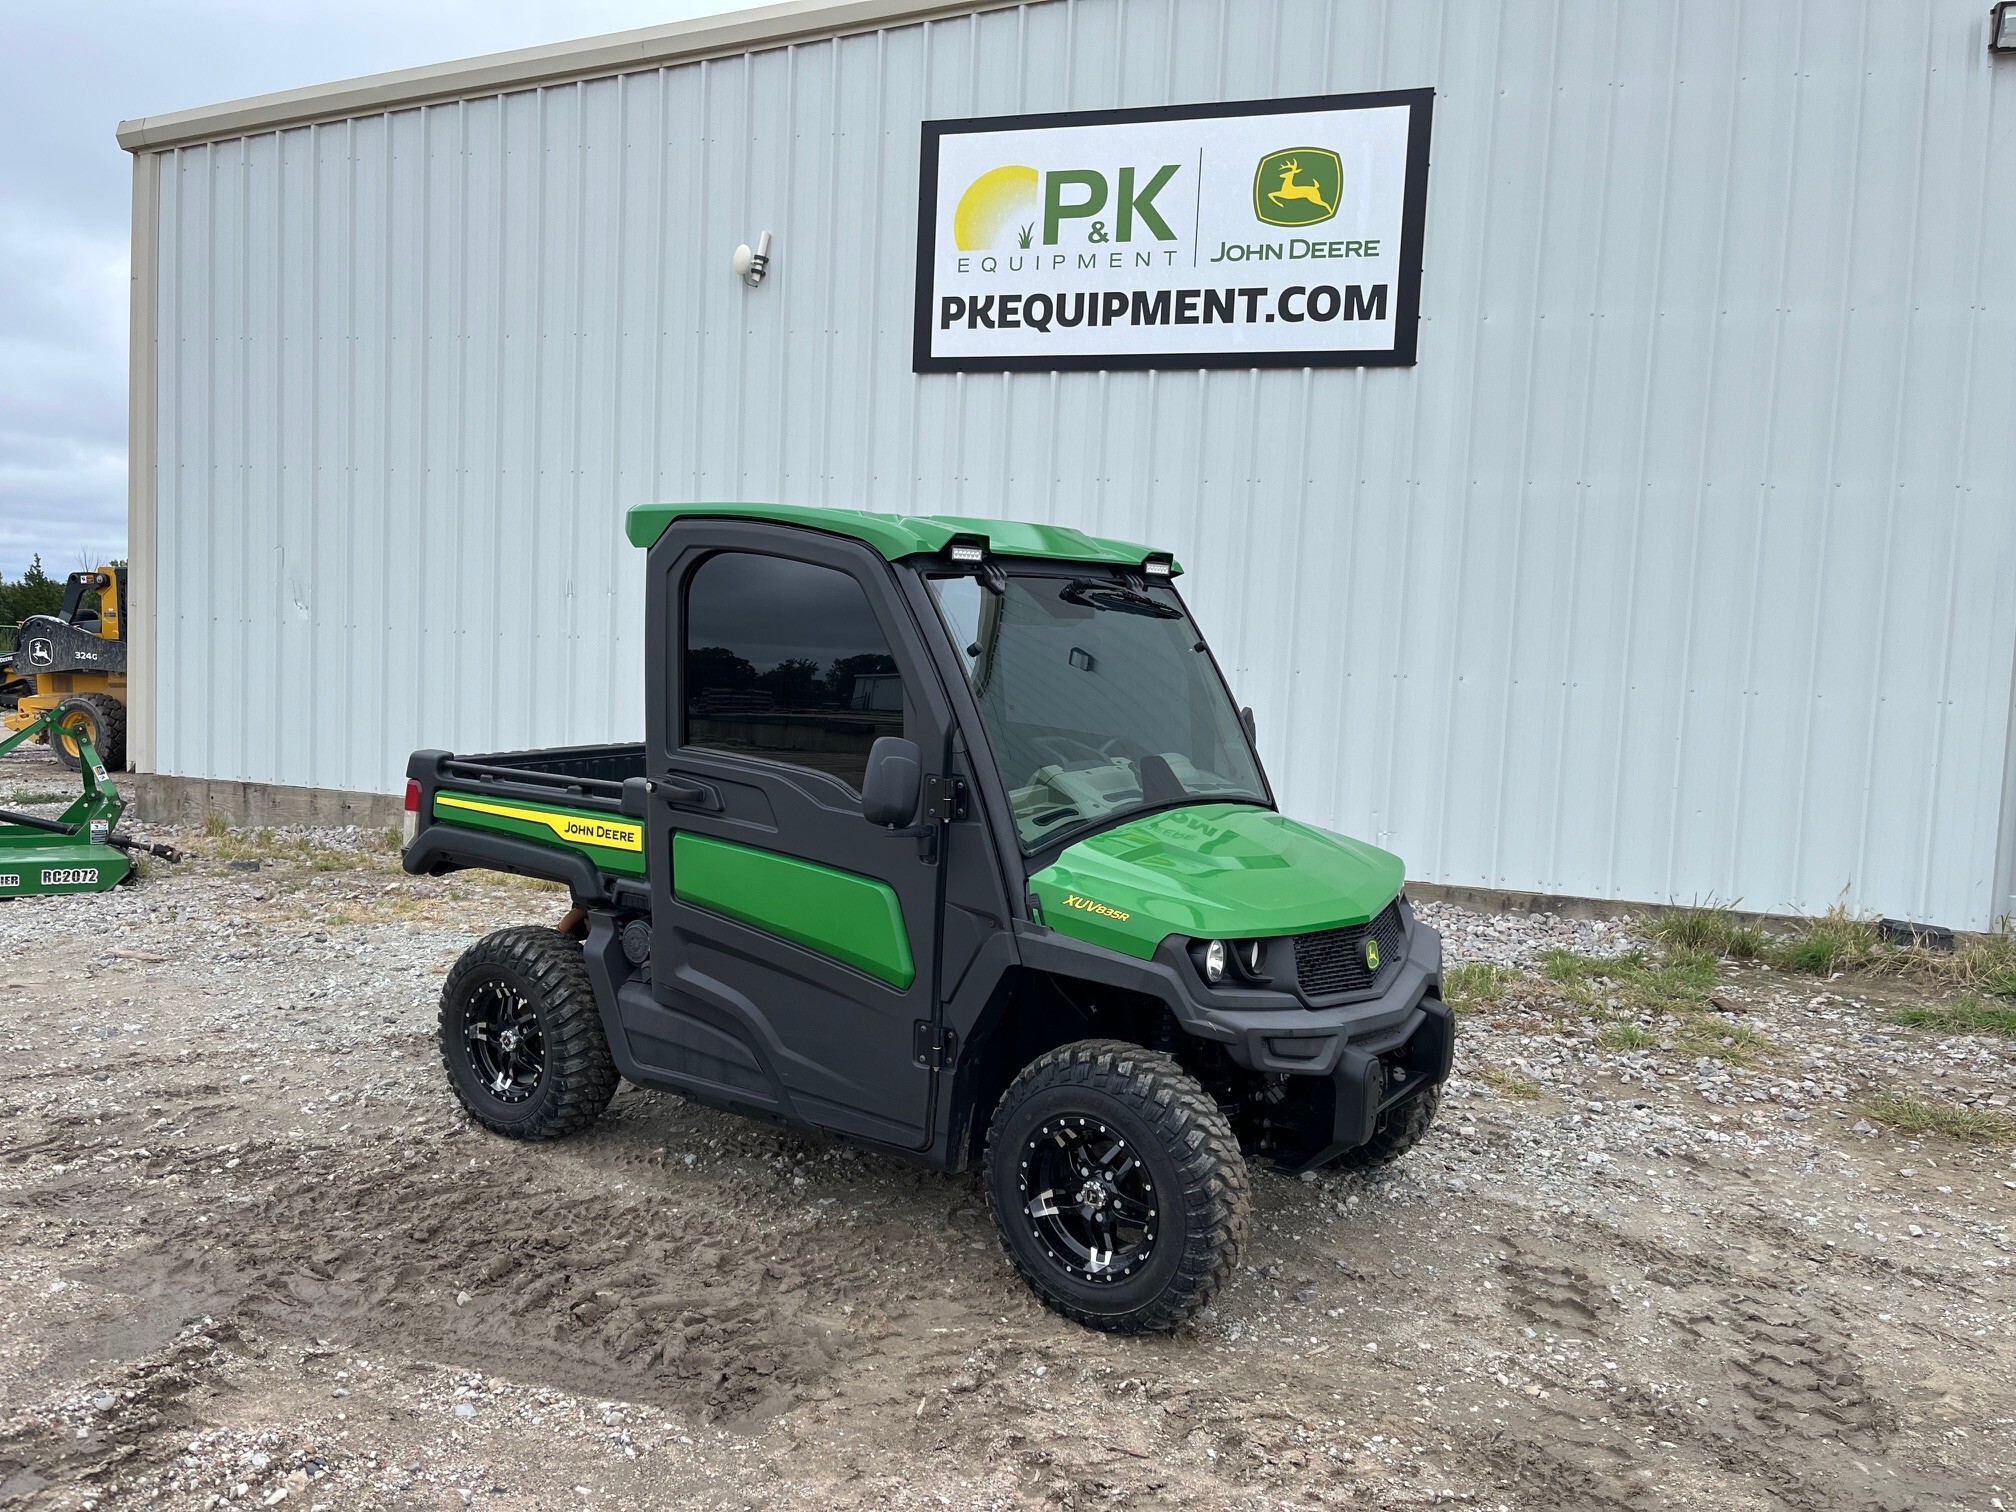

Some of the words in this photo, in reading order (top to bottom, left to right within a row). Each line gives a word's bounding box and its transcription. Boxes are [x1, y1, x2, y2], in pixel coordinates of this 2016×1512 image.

[1043, 164, 1182, 245] P&K
[957, 250, 1179, 273] EQUIPMENT
[1210, 241, 1284, 263] JOHN
[1289, 239, 1381, 260] DEERE
[940, 283, 1389, 333] PKEQUIPMENT.COM
[74, 651, 98, 661] 324G
[564, 821, 594, 837] JOHN
[596, 825, 635, 843] DEERE
[42, 869, 97, 884] RC2072
[1061, 894, 1131, 922] XUV835R
